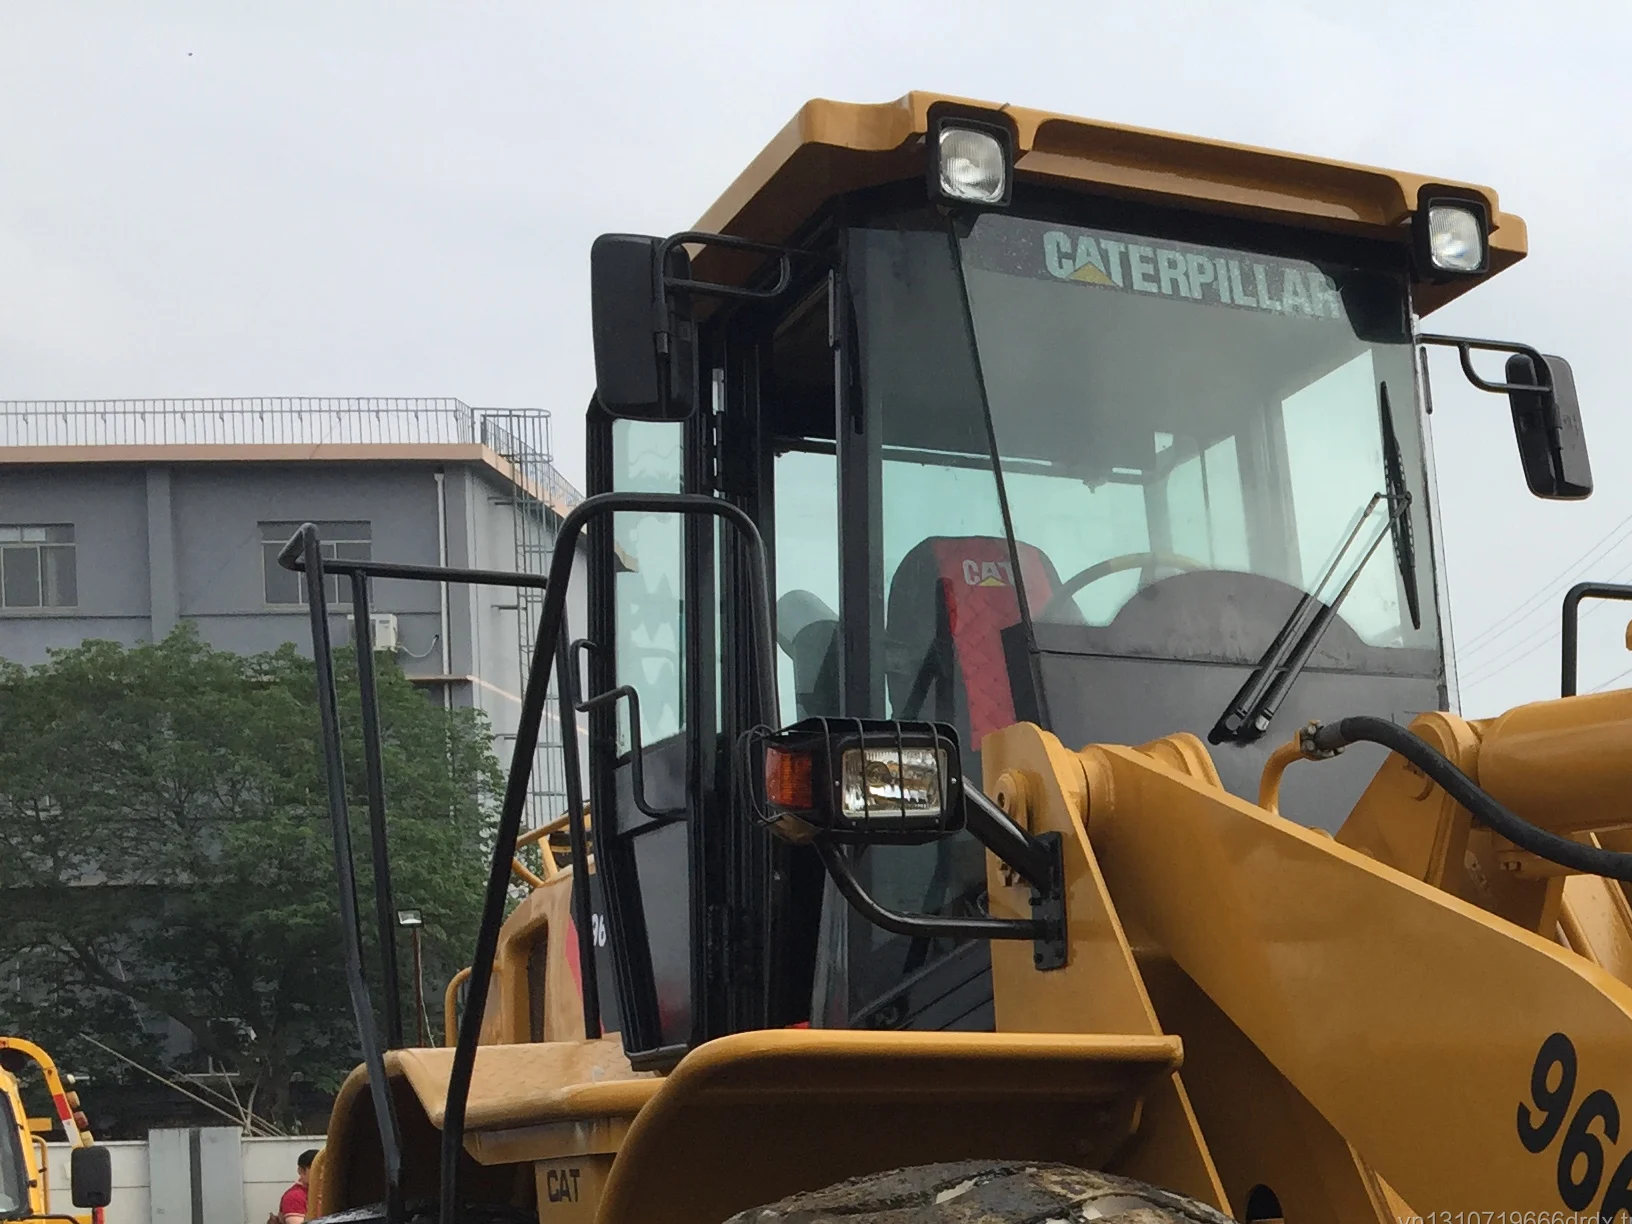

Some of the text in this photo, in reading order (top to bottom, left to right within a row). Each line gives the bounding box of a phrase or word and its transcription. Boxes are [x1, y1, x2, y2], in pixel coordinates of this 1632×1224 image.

[1043, 231, 1341, 319] CATERPILLAR
[962, 559, 1016, 586] CAT
[547, 1168, 580, 1203] CAT
